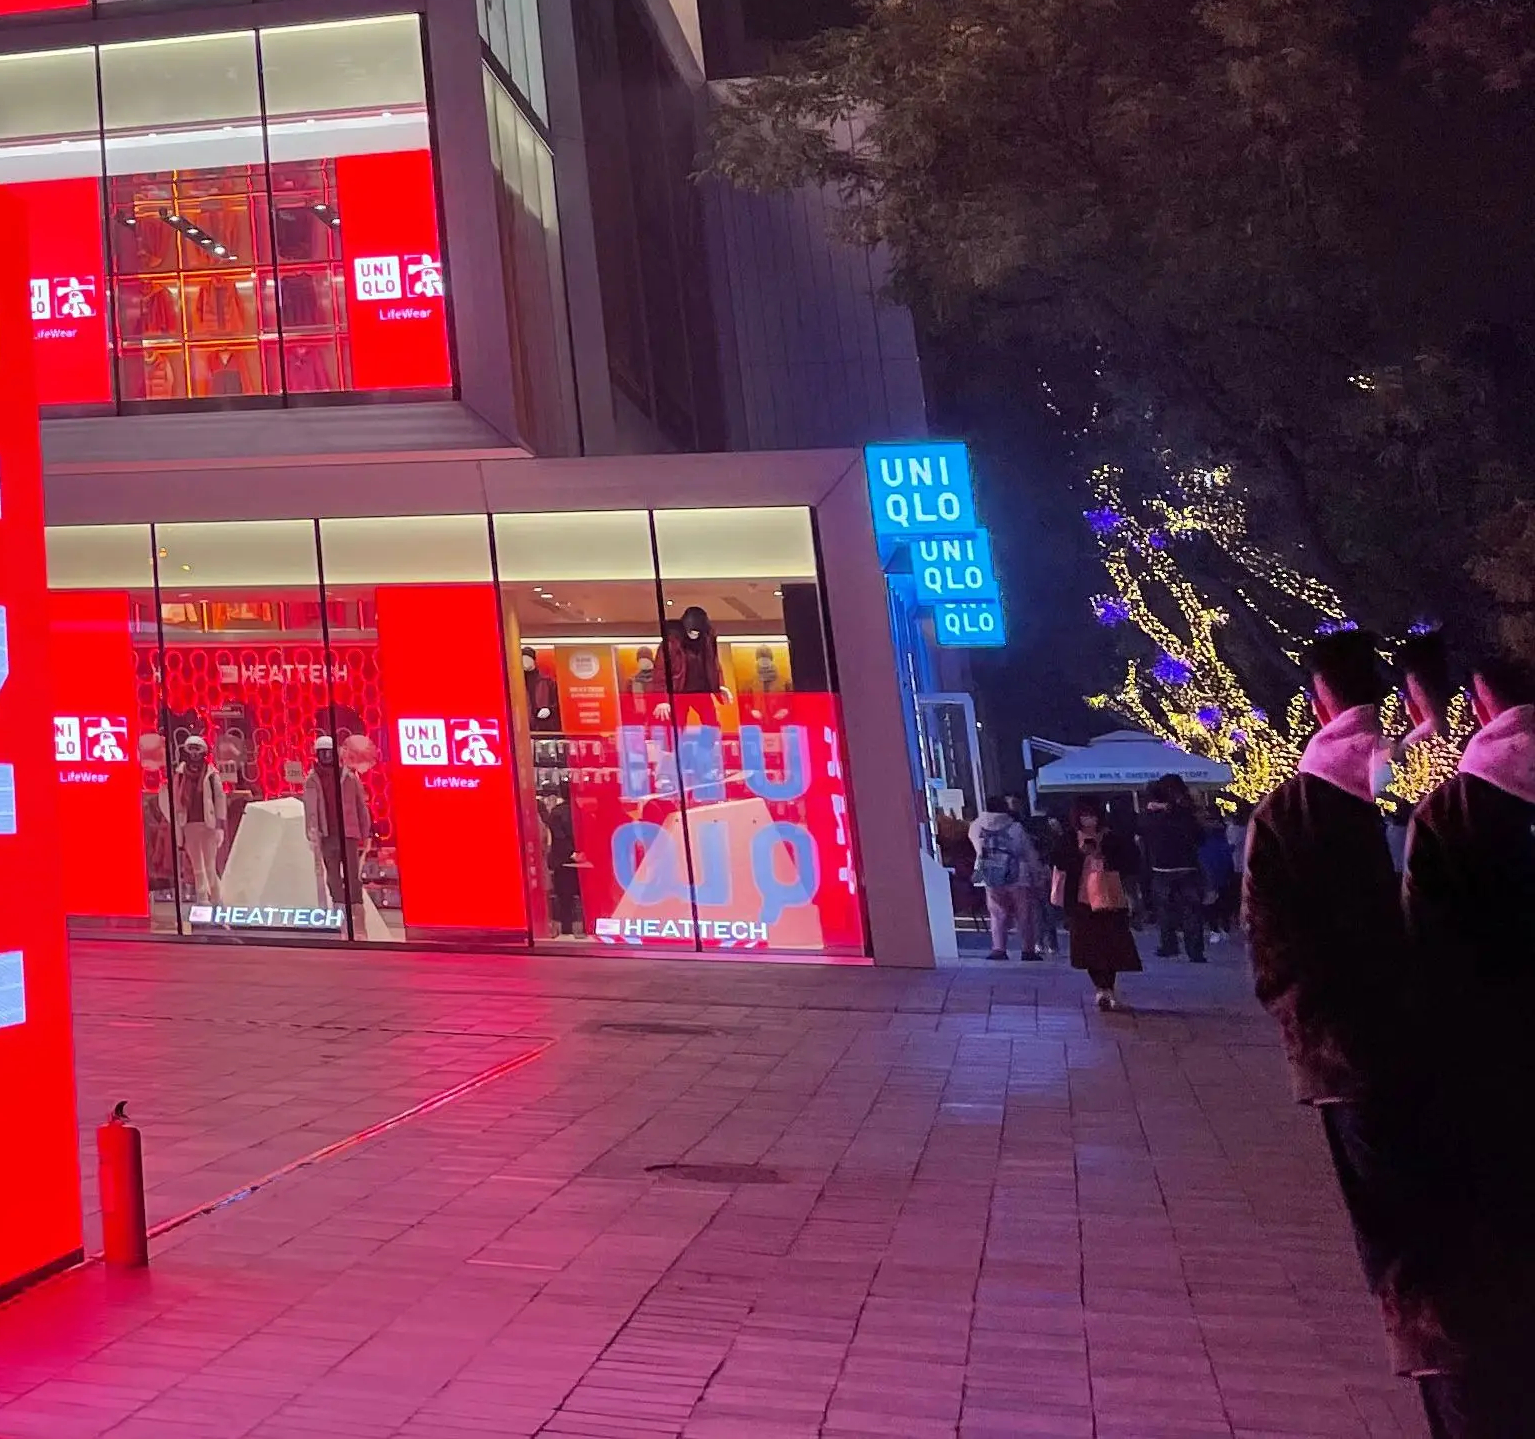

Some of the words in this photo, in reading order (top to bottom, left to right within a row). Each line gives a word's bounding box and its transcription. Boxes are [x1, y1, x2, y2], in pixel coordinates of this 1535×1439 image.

[360, 262, 391, 277] UNI
[362, 279, 396, 297] QLO
[379, 308, 433, 321] LifeWear
[880, 456, 950, 488] UNI
[885, 491, 961, 528] QLO
[919, 539, 975, 562] UNI
[923, 566, 984, 595] QLO
[944, 612, 995, 636] QLO
[240, 663, 349, 684] HEATTECH
[404, 724, 439, 741] UNI
[406, 743, 442, 762] QLO
[58, 770, 111, 784] LifeWear
[424, 775, 481, 789] LifeWear
[214, 905, 343, 927] HEATTECH
[624, 918, 768, 940] HEATTECH
